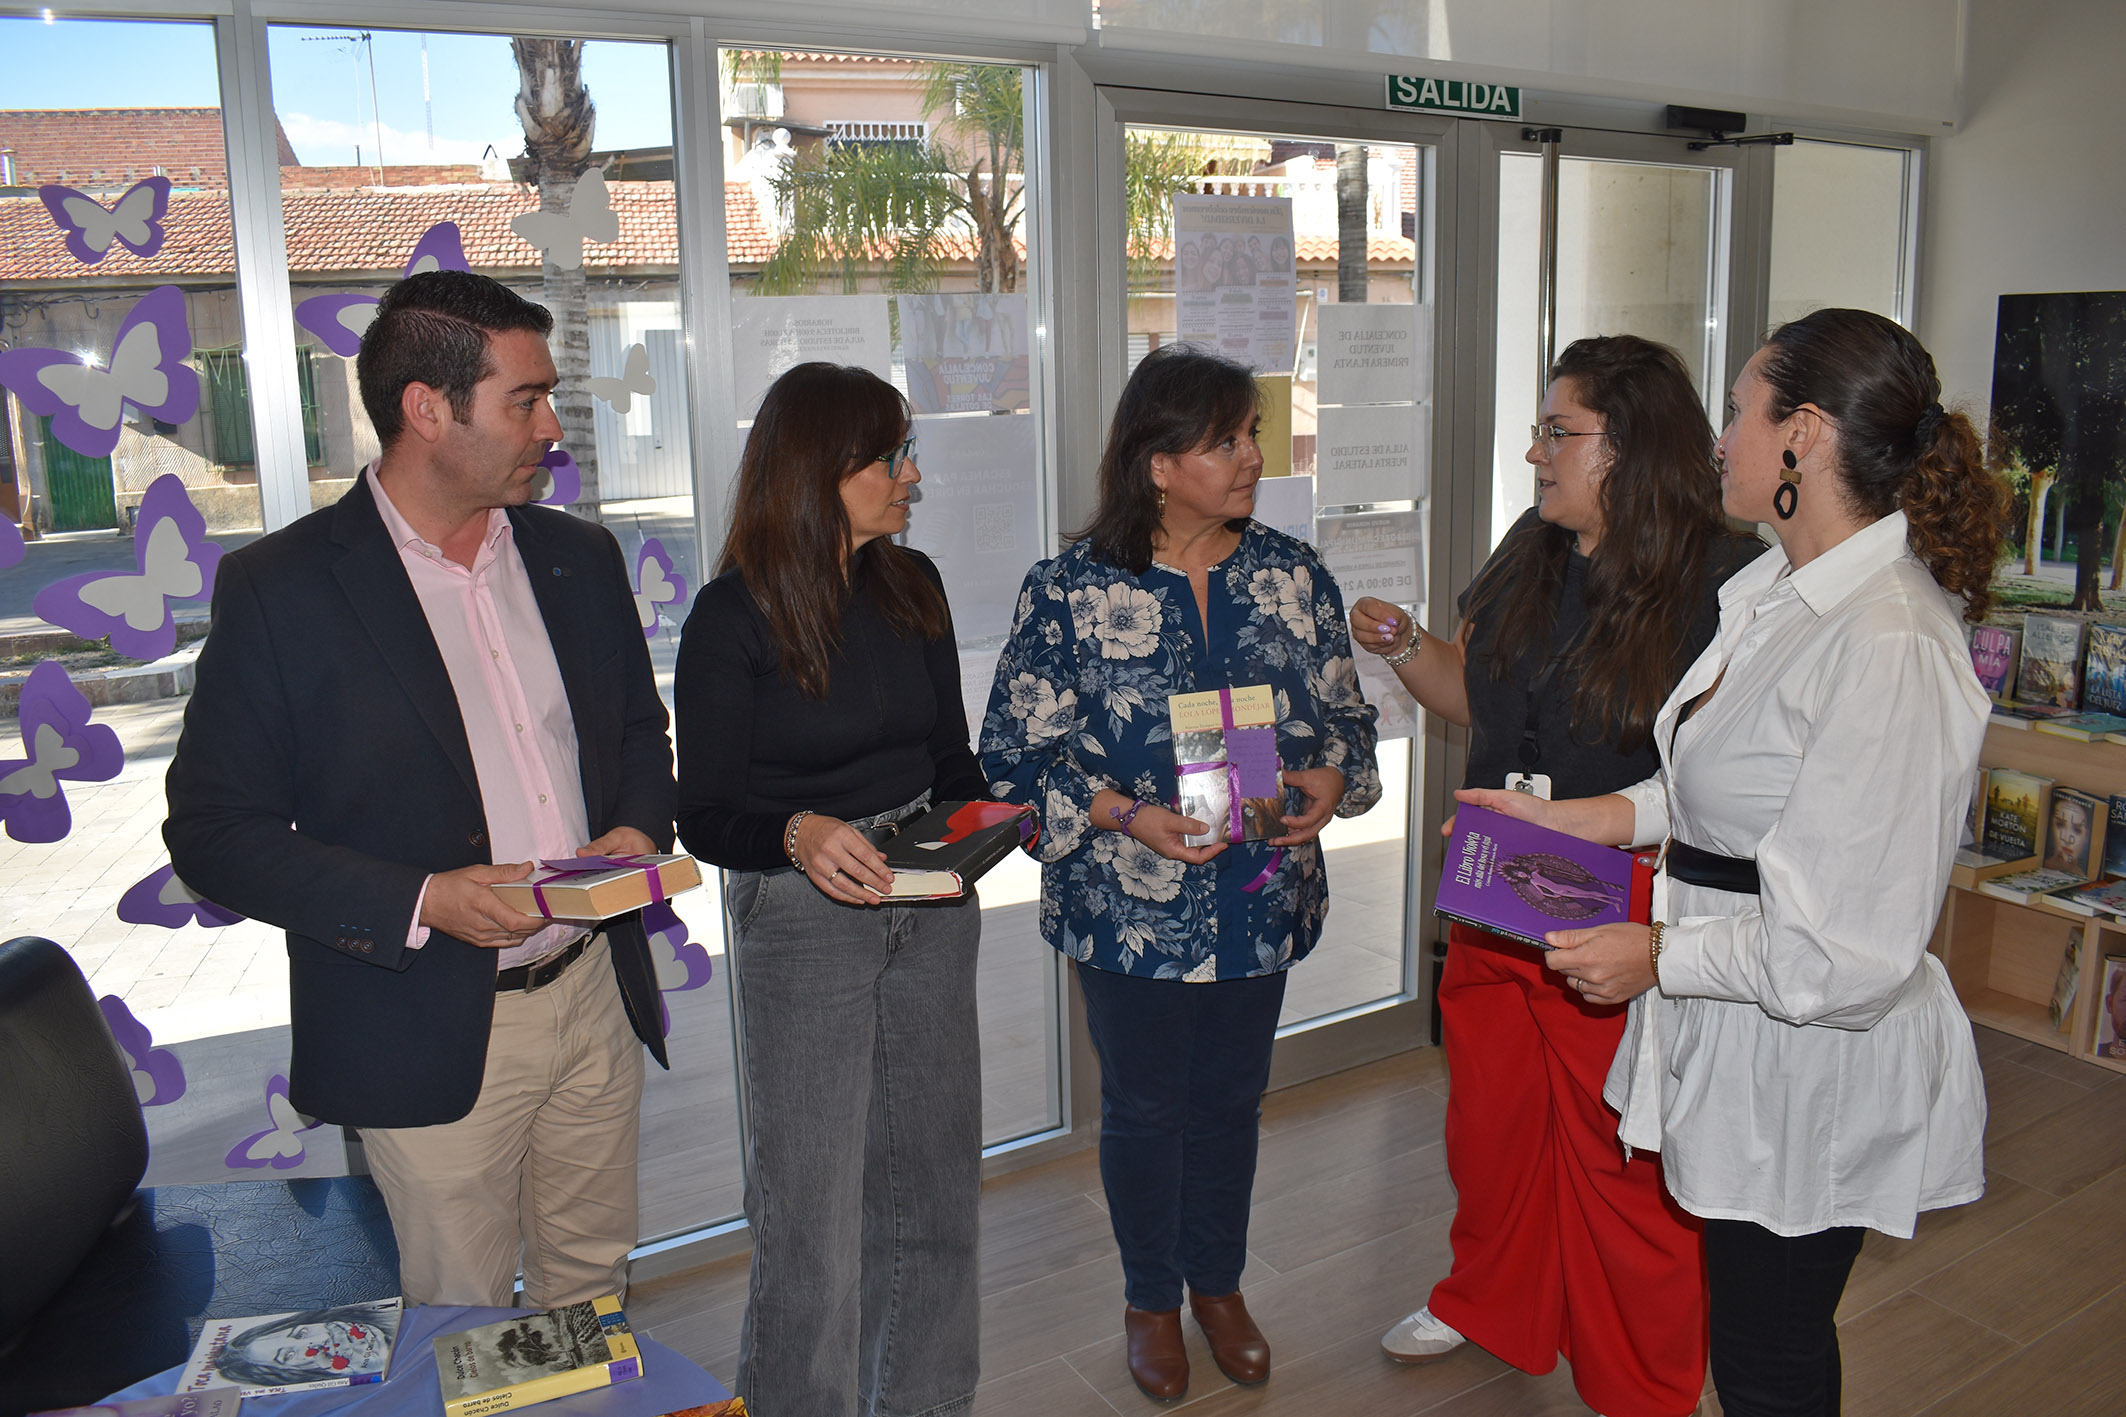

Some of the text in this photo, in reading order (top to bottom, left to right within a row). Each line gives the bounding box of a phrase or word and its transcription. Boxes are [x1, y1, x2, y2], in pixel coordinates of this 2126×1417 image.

[1397, 76, 1511, 112] SALIDA
[1972, 629, 2011, 656] CULPA
[2091, 686, 2121, 700] LA LISTA
[1178, 701, 1196, 709] Cada
[1236, 695, 1256, 703] noche
[1179, 709, 1199, 719] LOLA
[2000, 811, 2020, 822] KATE
[1991, 817, 2027, 833] MORTON
[1989, 830, 2026, 848] DE VUELTA
[1455, 831, 1481, 885] El Libro Violeta
[451, 1345, 466, 1380] Dulce Chacón
[469, 1362, 479, 1378] Cielos
[462, 1400, 481, 1409] barro
[492, 1392, 513, 1402] Cielos
[464, 1401, 510, 1416] Dulce Chacón
